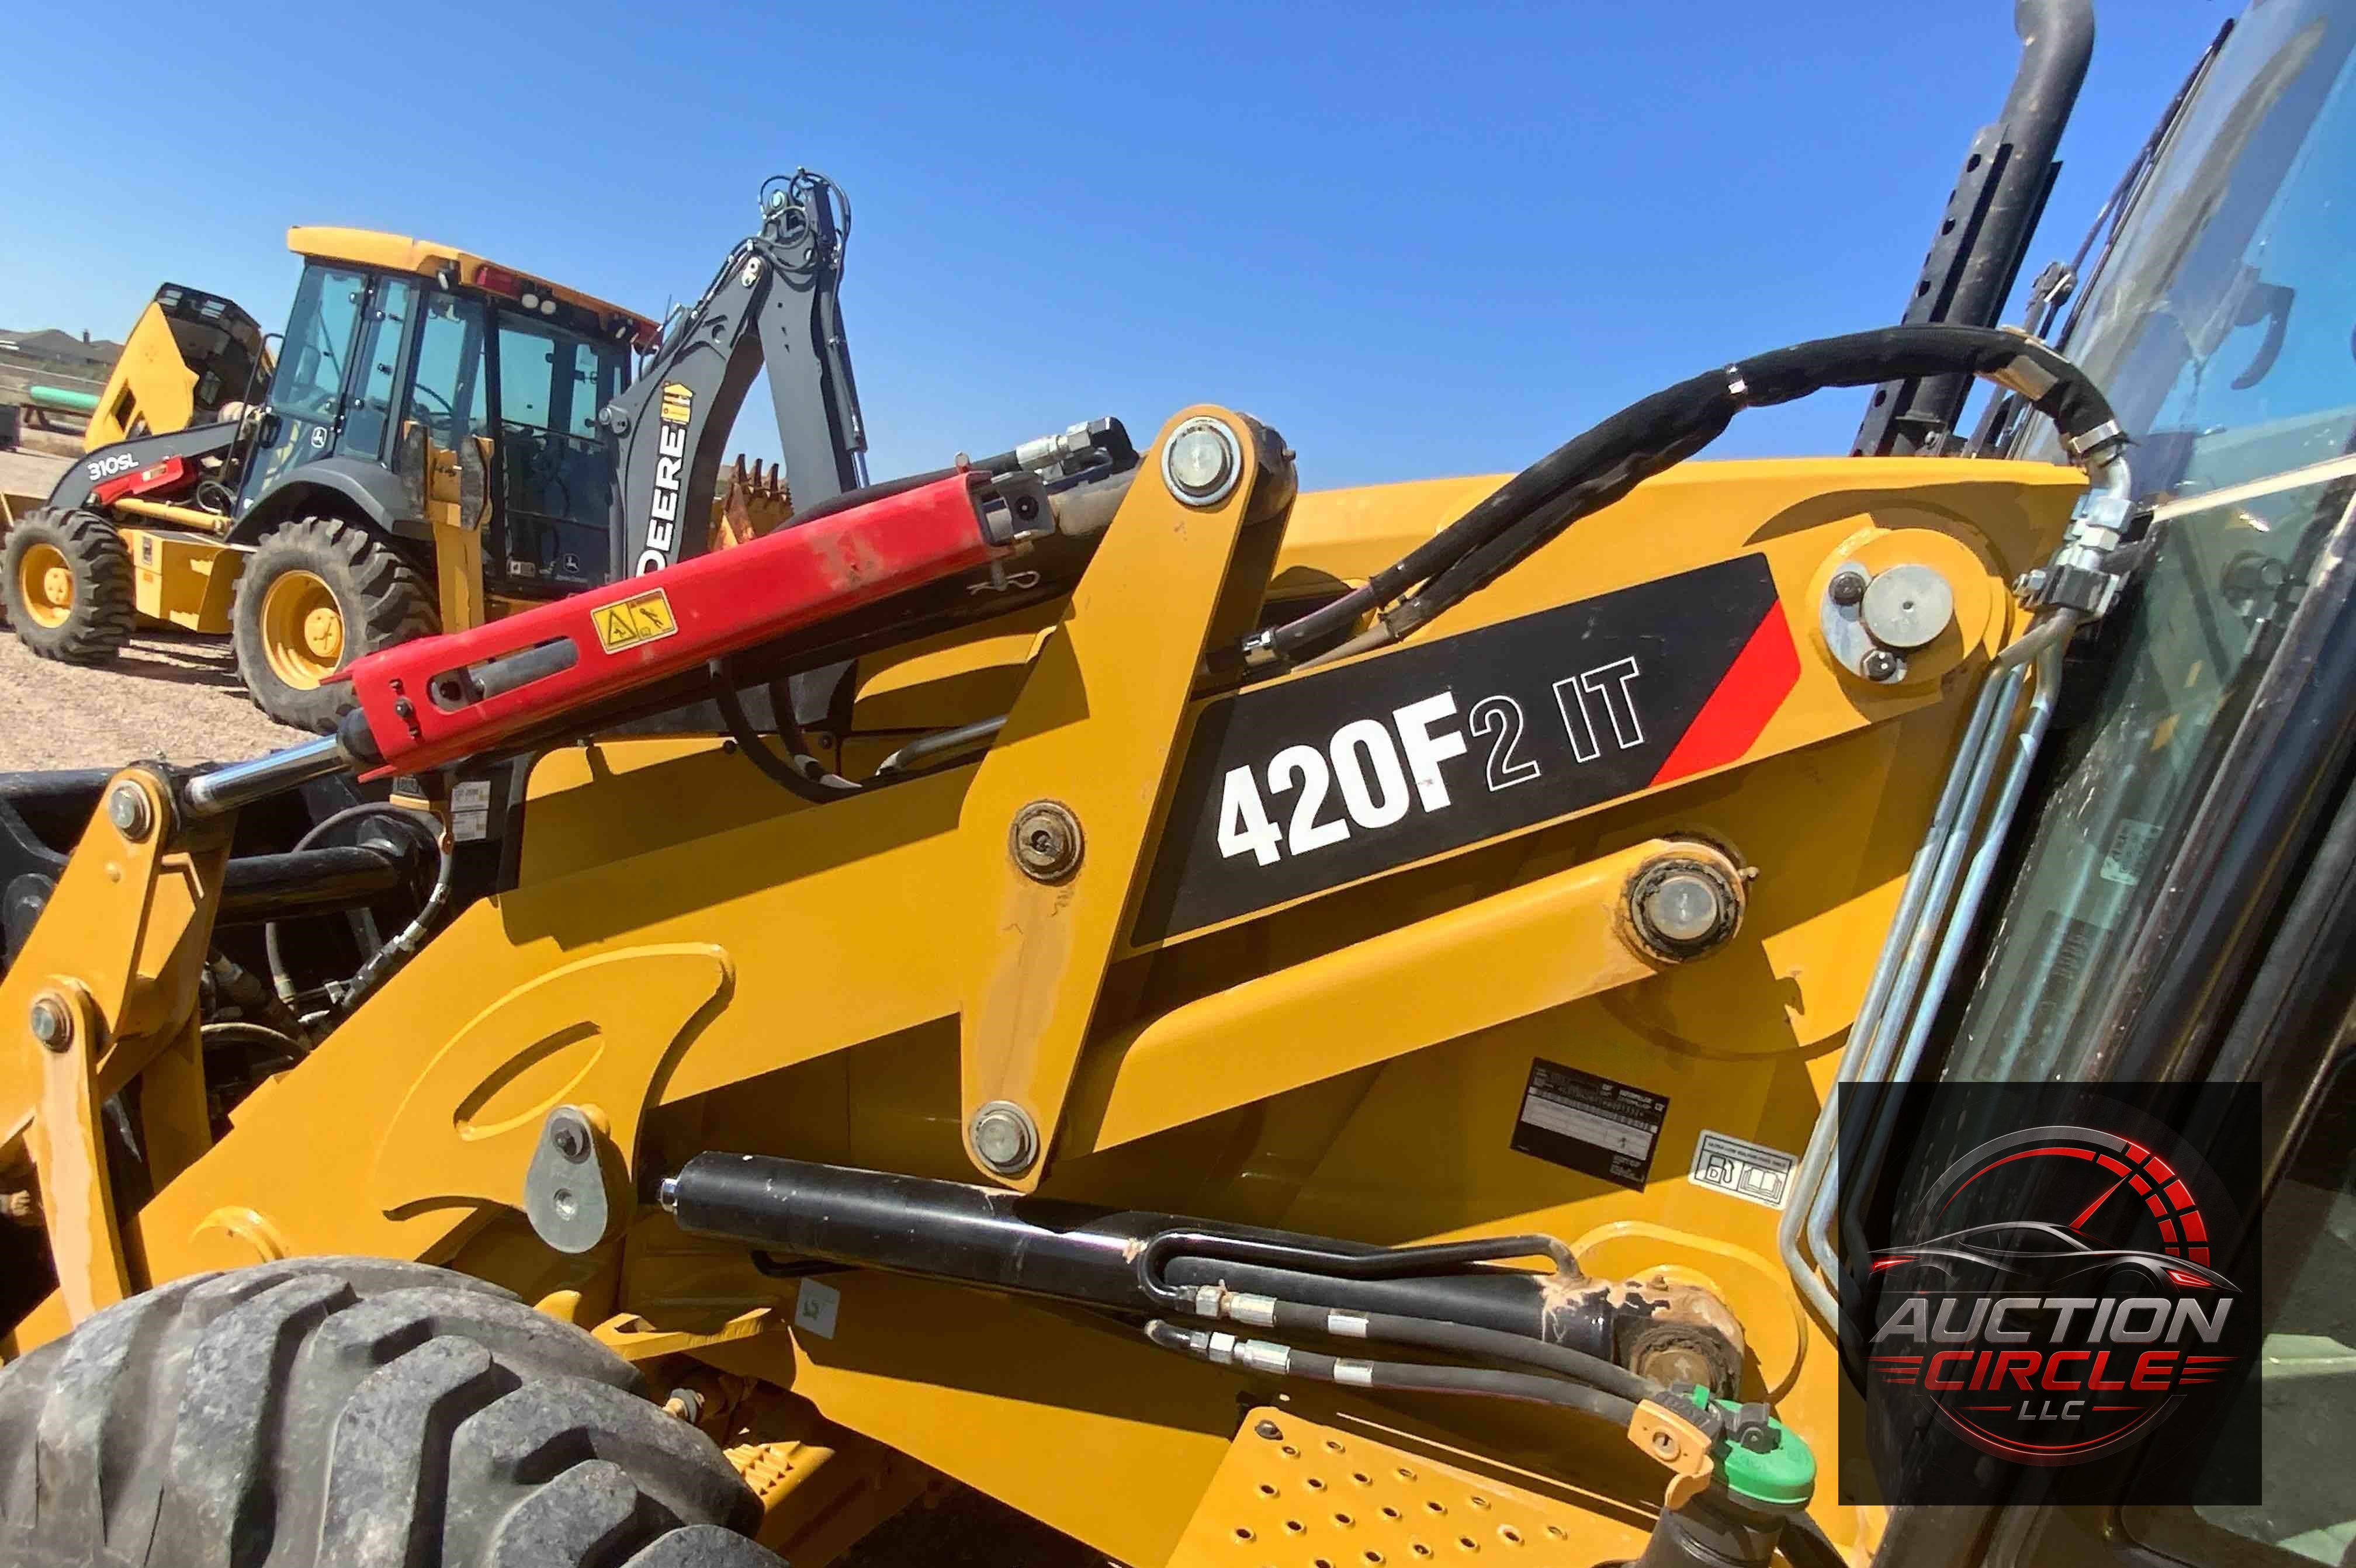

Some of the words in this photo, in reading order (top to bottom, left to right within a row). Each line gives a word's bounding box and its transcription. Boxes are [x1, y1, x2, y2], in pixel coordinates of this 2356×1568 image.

[88, 453, 139, 481] 310SL
[636, 425, 687, 577] DEERE
[1553, 656, 1644, 763] IT
